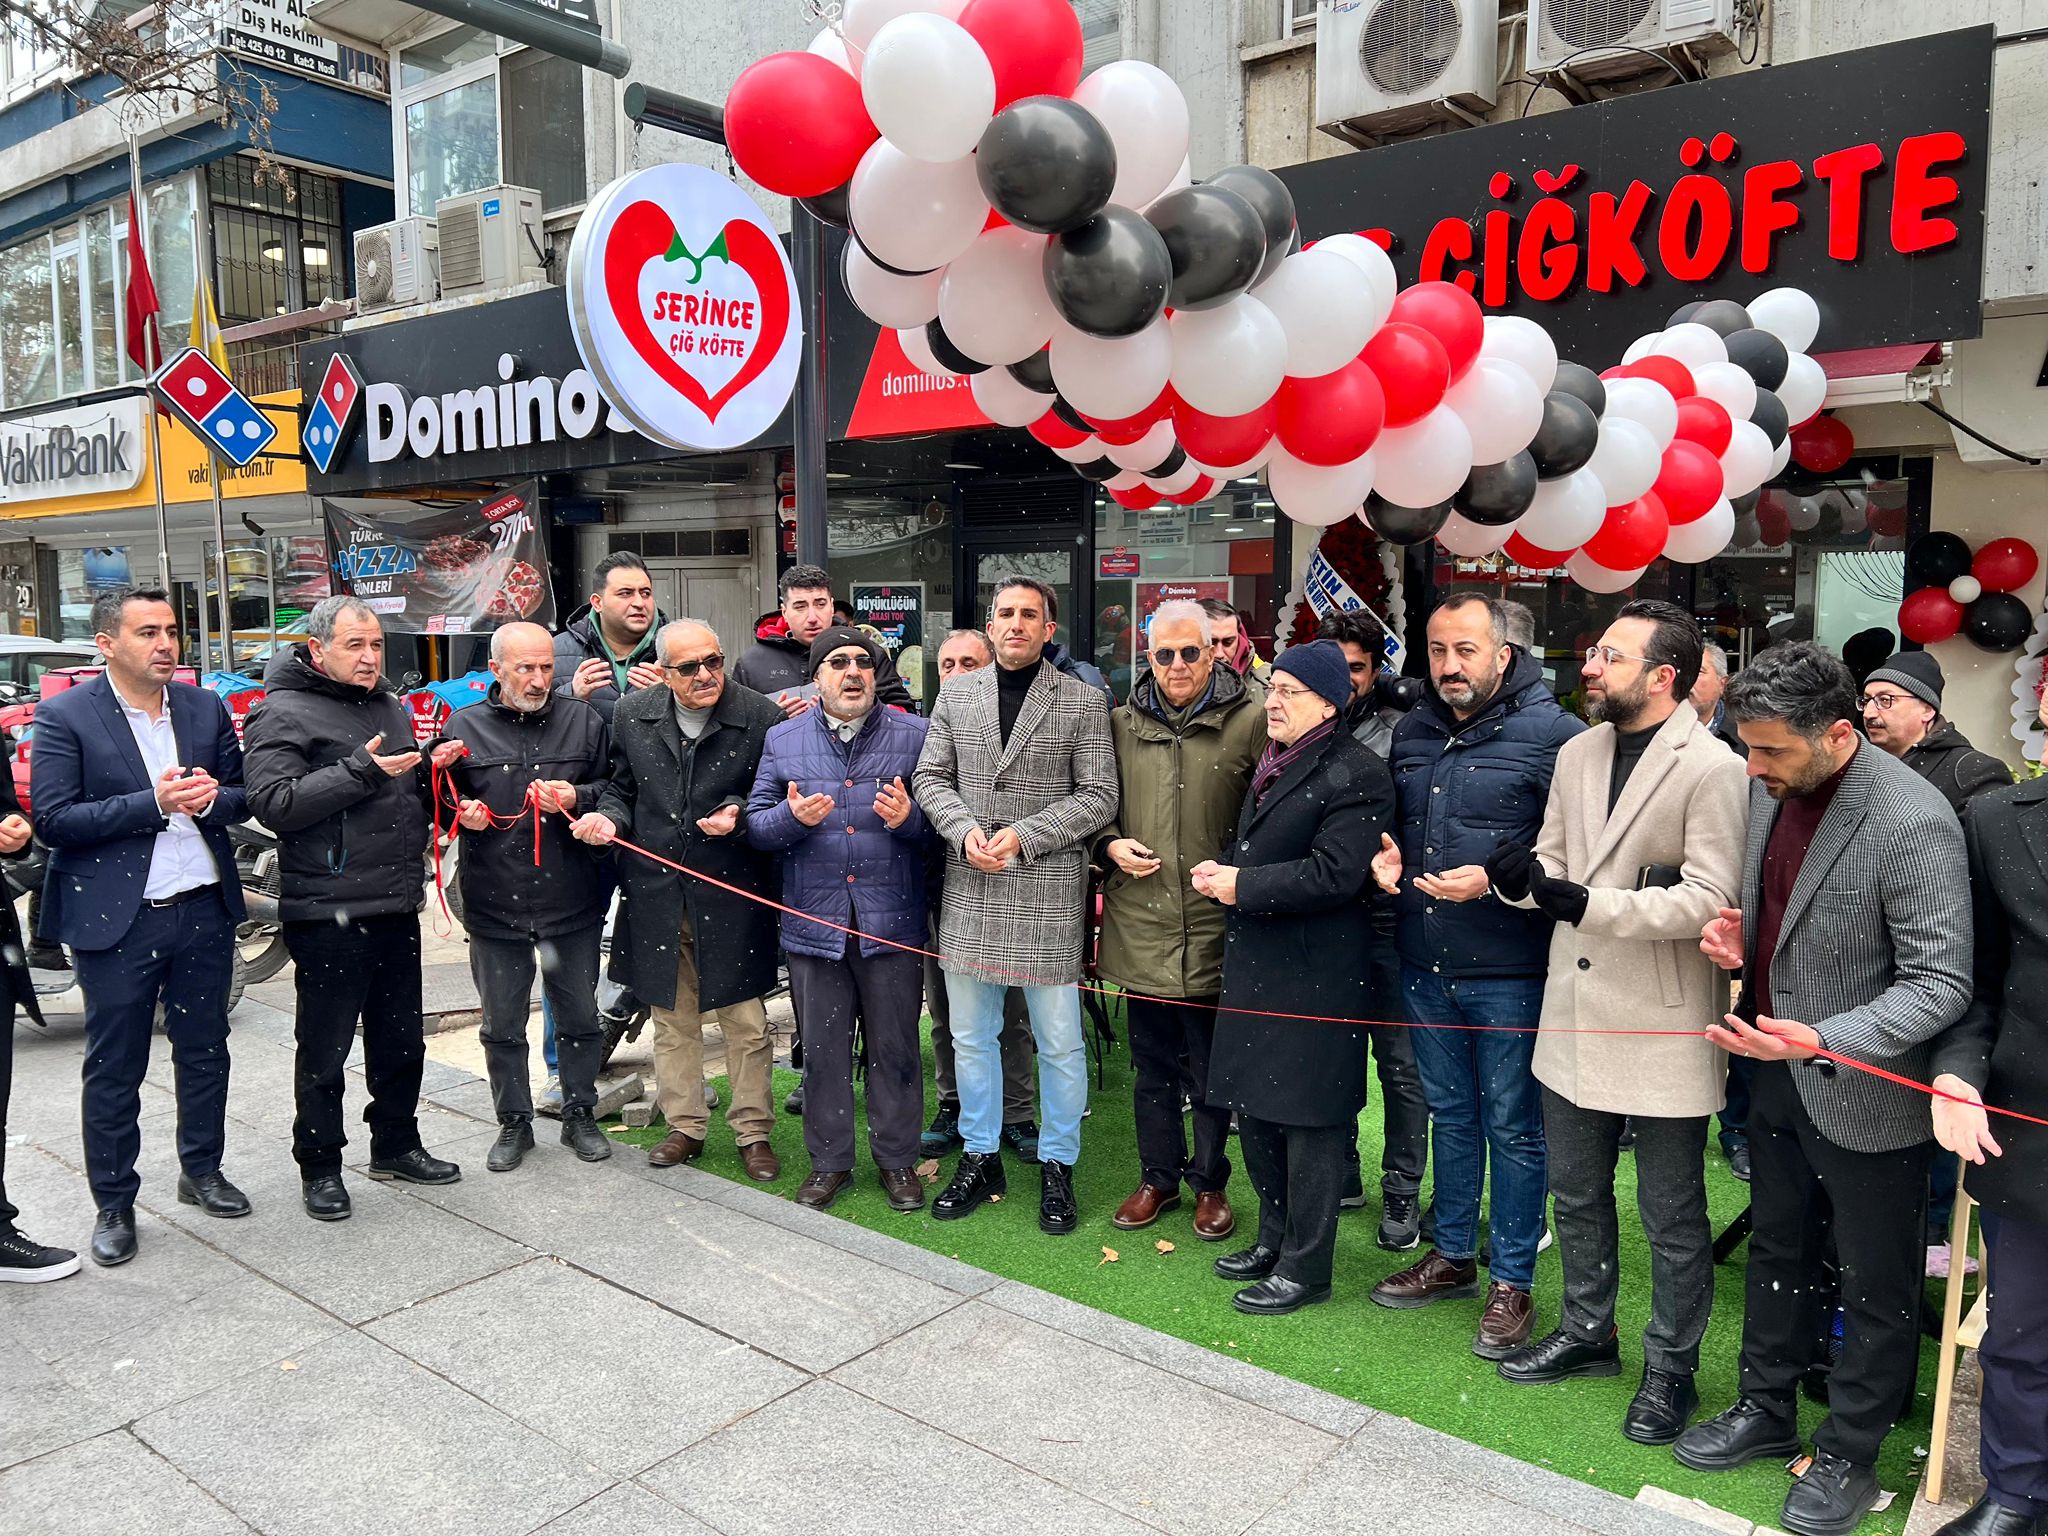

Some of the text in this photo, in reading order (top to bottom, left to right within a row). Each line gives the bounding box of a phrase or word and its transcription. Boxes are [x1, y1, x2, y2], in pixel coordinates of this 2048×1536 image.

[242, 9, 266, 33] Diş
[247, 40, 263, 54] 425
[263, 45, 275, 56] 49
[275, 48, 287, 60] 12
[293, 53, 315, 70] Kat:2
[317, 61, 336, 76] No:6
[654, 289, 755, 330] SERİNCE
[669, 329, 745, 358] ÇİĞ KÖFTE
[338, 544, 417, 581] PİZZA
[353, 576, 393, 596] GÜNLERİ
[1168, 586, 1197, 595] Domino's
[857, 595, 917, 611] BÜYÜKLÜĞÜN
[890, 612, 905, 621] YOK
